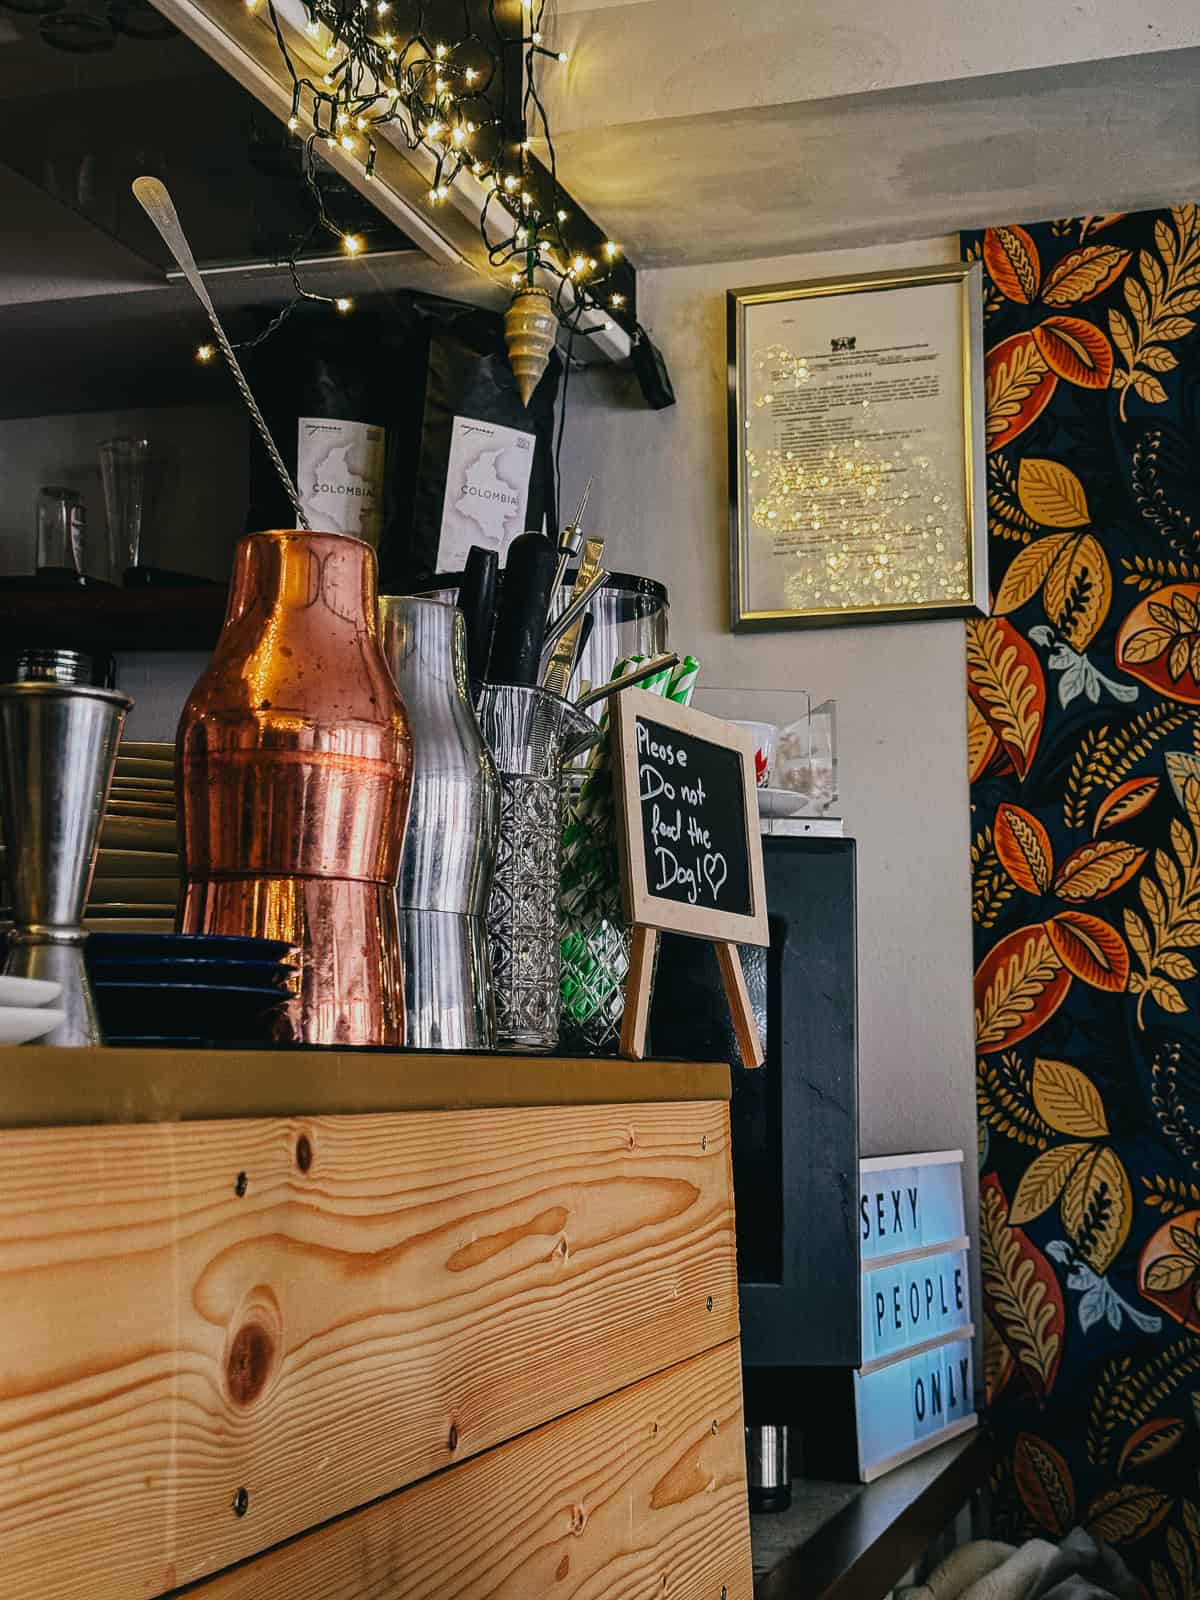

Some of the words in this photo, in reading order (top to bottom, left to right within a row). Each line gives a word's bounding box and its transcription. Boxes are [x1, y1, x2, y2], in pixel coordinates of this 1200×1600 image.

[312, 483, 376, 497] COLOMBIA
[461, 485, 519, 505] COLOMBIA
[636, 722, 688, 767] Please
[639, 764, 676, 800] Do
[681, 777, 706, 805] not
[687, 816, 712, 849] the
[655, 847, 702, 904] Dog!
[860, 1187, 919, 1240] SEXY
[876, 1269, 963, 1337] PEOPLE
[914, 1357, 969, 1422] ONLY
